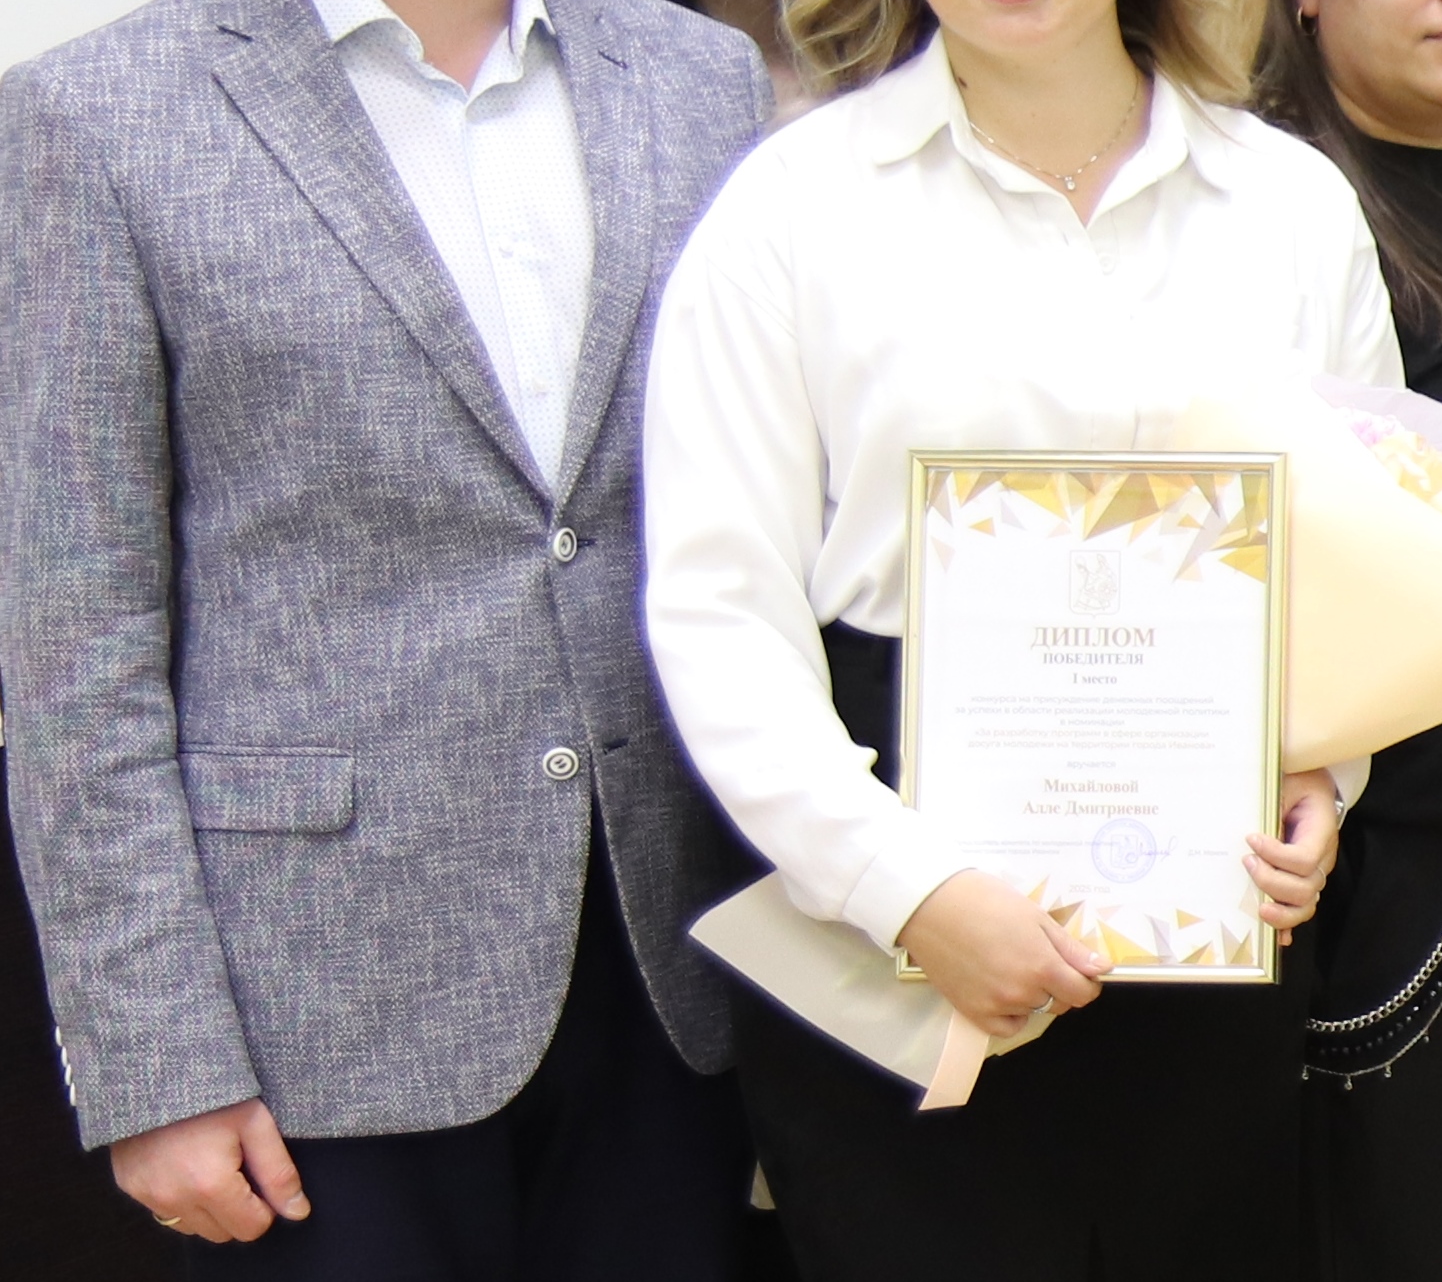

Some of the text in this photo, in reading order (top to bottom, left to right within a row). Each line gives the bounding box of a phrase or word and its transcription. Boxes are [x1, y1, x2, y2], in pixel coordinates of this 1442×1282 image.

[1030, 626, 1157, 650] ДИПЛОМ
[1043, 652, 1144, 666] ПОБЕДИТЕЛЯ
[1082, 675, 1118, 685] место
[1066, 760, 1117, 769] вручается
[1043, 778, 1139, 793] Михайловой
[1022, 800, 1160, 819] Алле Дмитриевне
